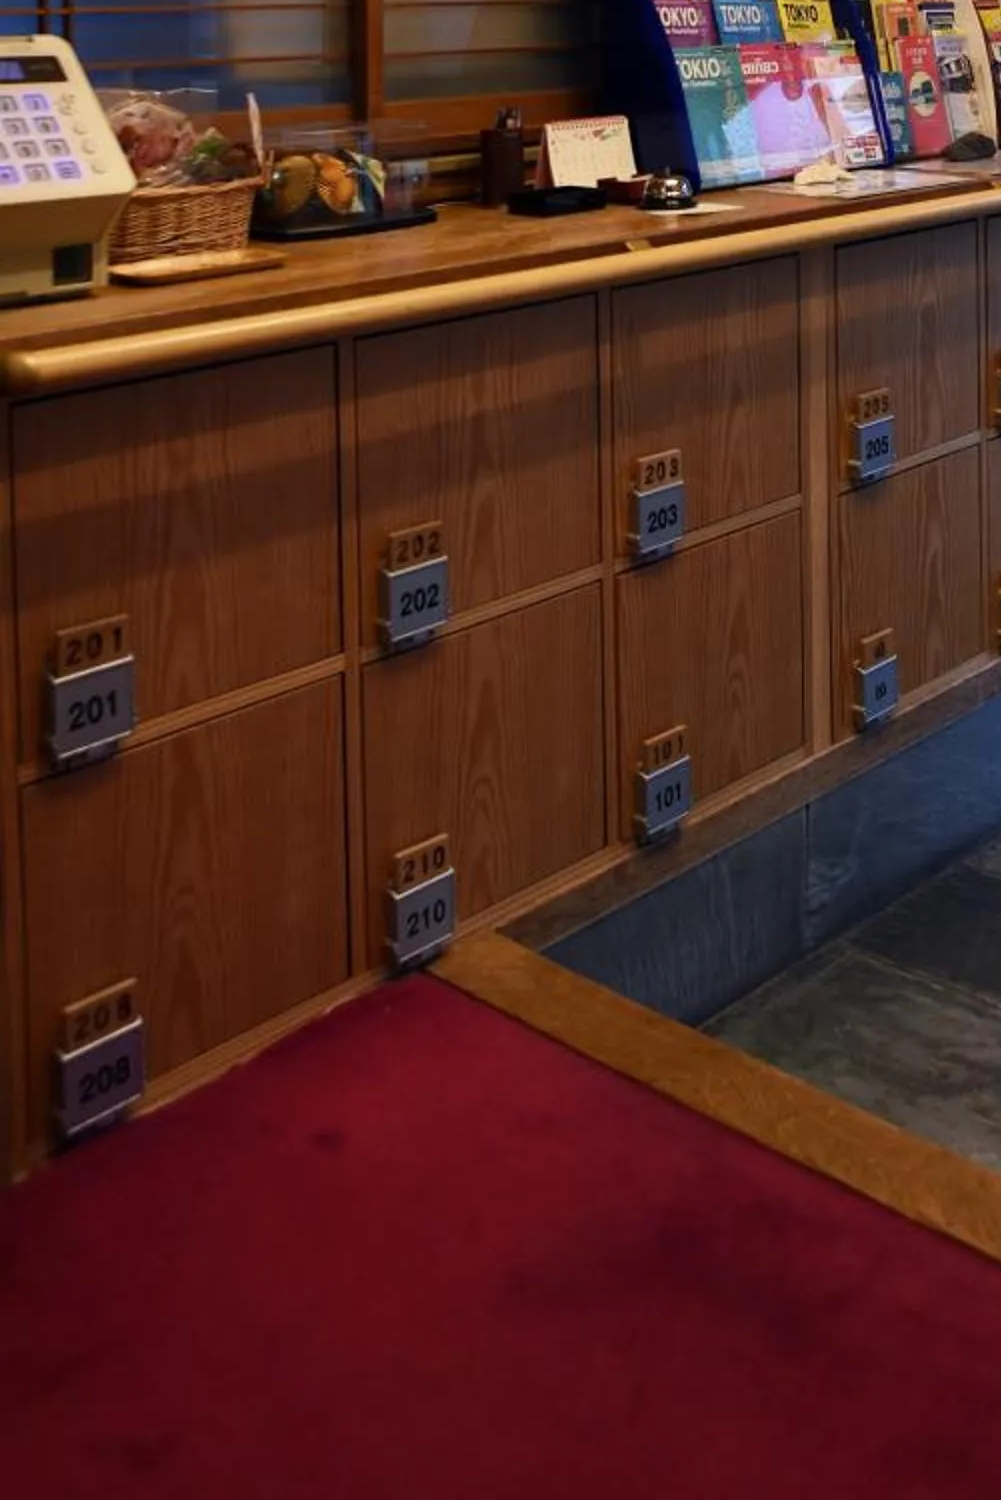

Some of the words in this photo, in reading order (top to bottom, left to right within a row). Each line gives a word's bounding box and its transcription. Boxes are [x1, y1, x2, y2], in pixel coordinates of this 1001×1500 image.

[719, 4, 761, 24] TOKYO
[865, 435, 889, 460] 205
[644, 457, 679, 484] 203
[647, 503, 678, 533] 203
[396, 531, 440, 563] 202
[400, 583, 440, 617] 202
[65, 627, 123, 667] 201
[68, 690, 118, 732] 201
[653, 735, 684, 765] 101
[655, 781, 682, 812] 101
[402, 845, 445, 885] 210
[406, 899, 446, 939] 210
